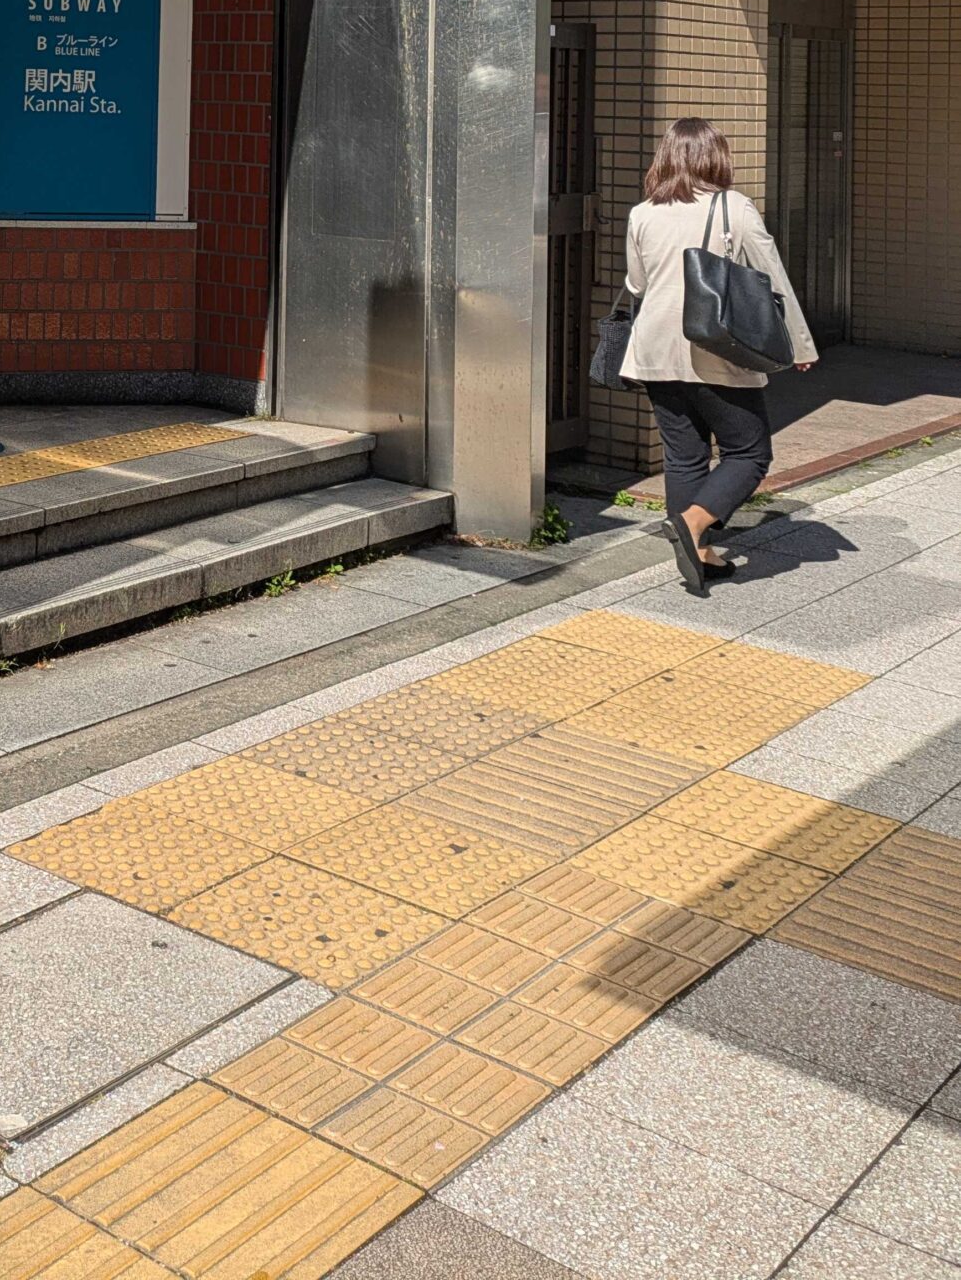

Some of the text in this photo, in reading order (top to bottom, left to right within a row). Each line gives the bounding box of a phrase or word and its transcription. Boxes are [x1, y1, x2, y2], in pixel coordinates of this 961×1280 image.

[37, 36, 47, 51] B
[56, 34, 118, 48] ブルーライン
[55, 46, 101, 57] BLUE LINE
[24, 68, 96, 94] 関内駅
[24, 95, 122, 114] Kannai Sta.
